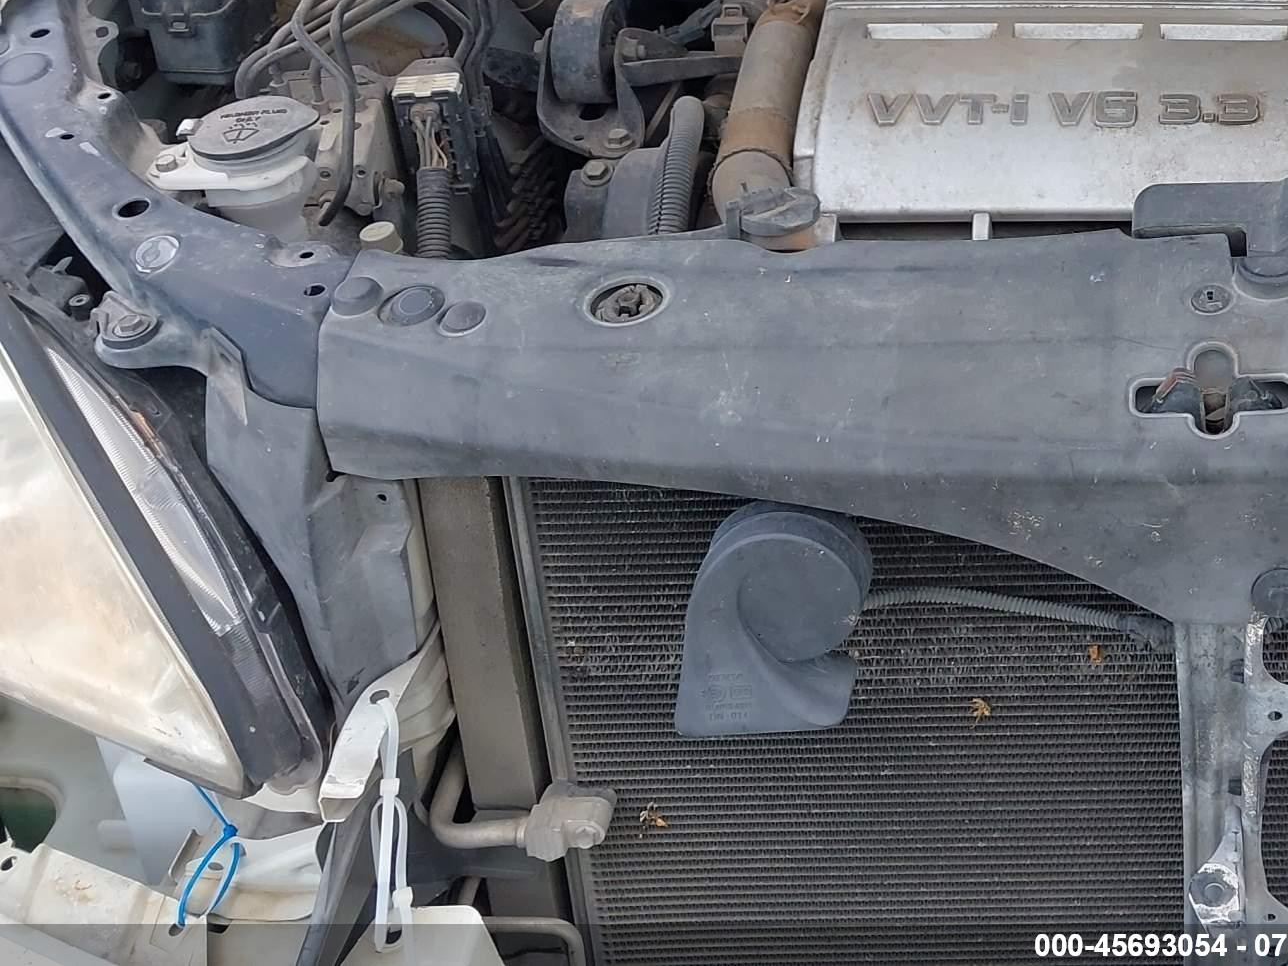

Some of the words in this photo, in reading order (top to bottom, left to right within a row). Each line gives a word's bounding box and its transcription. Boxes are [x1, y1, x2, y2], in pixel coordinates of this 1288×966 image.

[866, 93, 1029, 126] VVT-i
[1049, 91, 1138, 128] V6
[1159, 93, 1260, 125] 3.3
